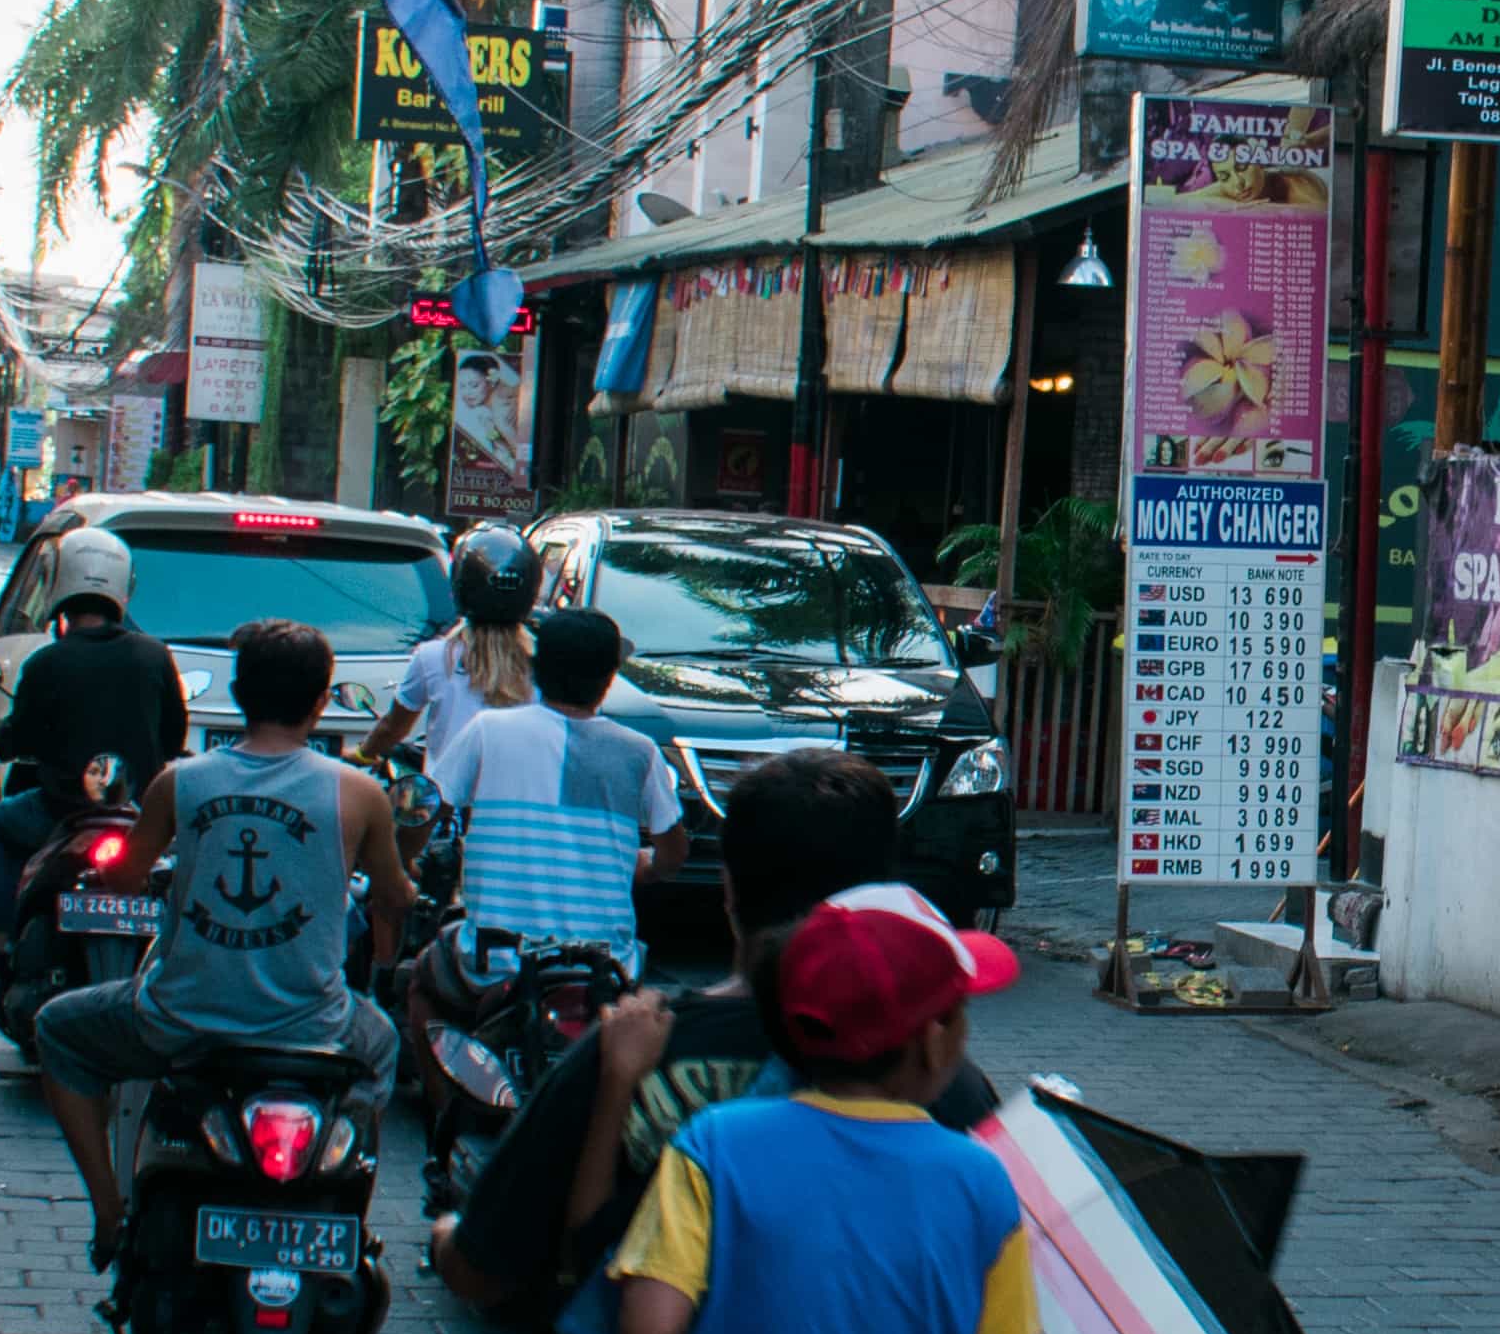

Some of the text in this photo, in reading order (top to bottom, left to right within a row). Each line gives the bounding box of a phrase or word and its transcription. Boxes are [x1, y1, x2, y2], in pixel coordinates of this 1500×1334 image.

[1449, 31, 1485, 47] AM
[397, 88, 436, 108] Bar
[1188, 113, 1289, 138] FAMILY
[1150, 138, 1326, 167] SPA & SALON
[1176, 485, 1284, 503] AUTHORIZED
[1137, 499, 1320, 545] MONEY CHANGER
[1139, 552, 1192, 562] RATE TO DAY
[1147, 565, 1306, 583] CURRENCY BANK NOTE
[1169, 586, 1205, 603] USD
[1169, 610, 1208, 627] AUD
[1168, 636, 1219, 652] EURO
[1167, 660, 1205, 677] GPB
[1166, 685, 1205, 702] CAD
[1165, 710, 1284, 729] JPY 122
[1166, 735, 1203, 751] CHF
[1165, 760, 1203, 776] SGD
[1164, 785, 1201, 801] NZD
[1164, 809, 1202, 826] MAL
[1163, 834, 1201, 851] HKD
[1163, 859, 1203, 875] RMB
[207, 1215, 347, 1247] DK 6717 ZP
